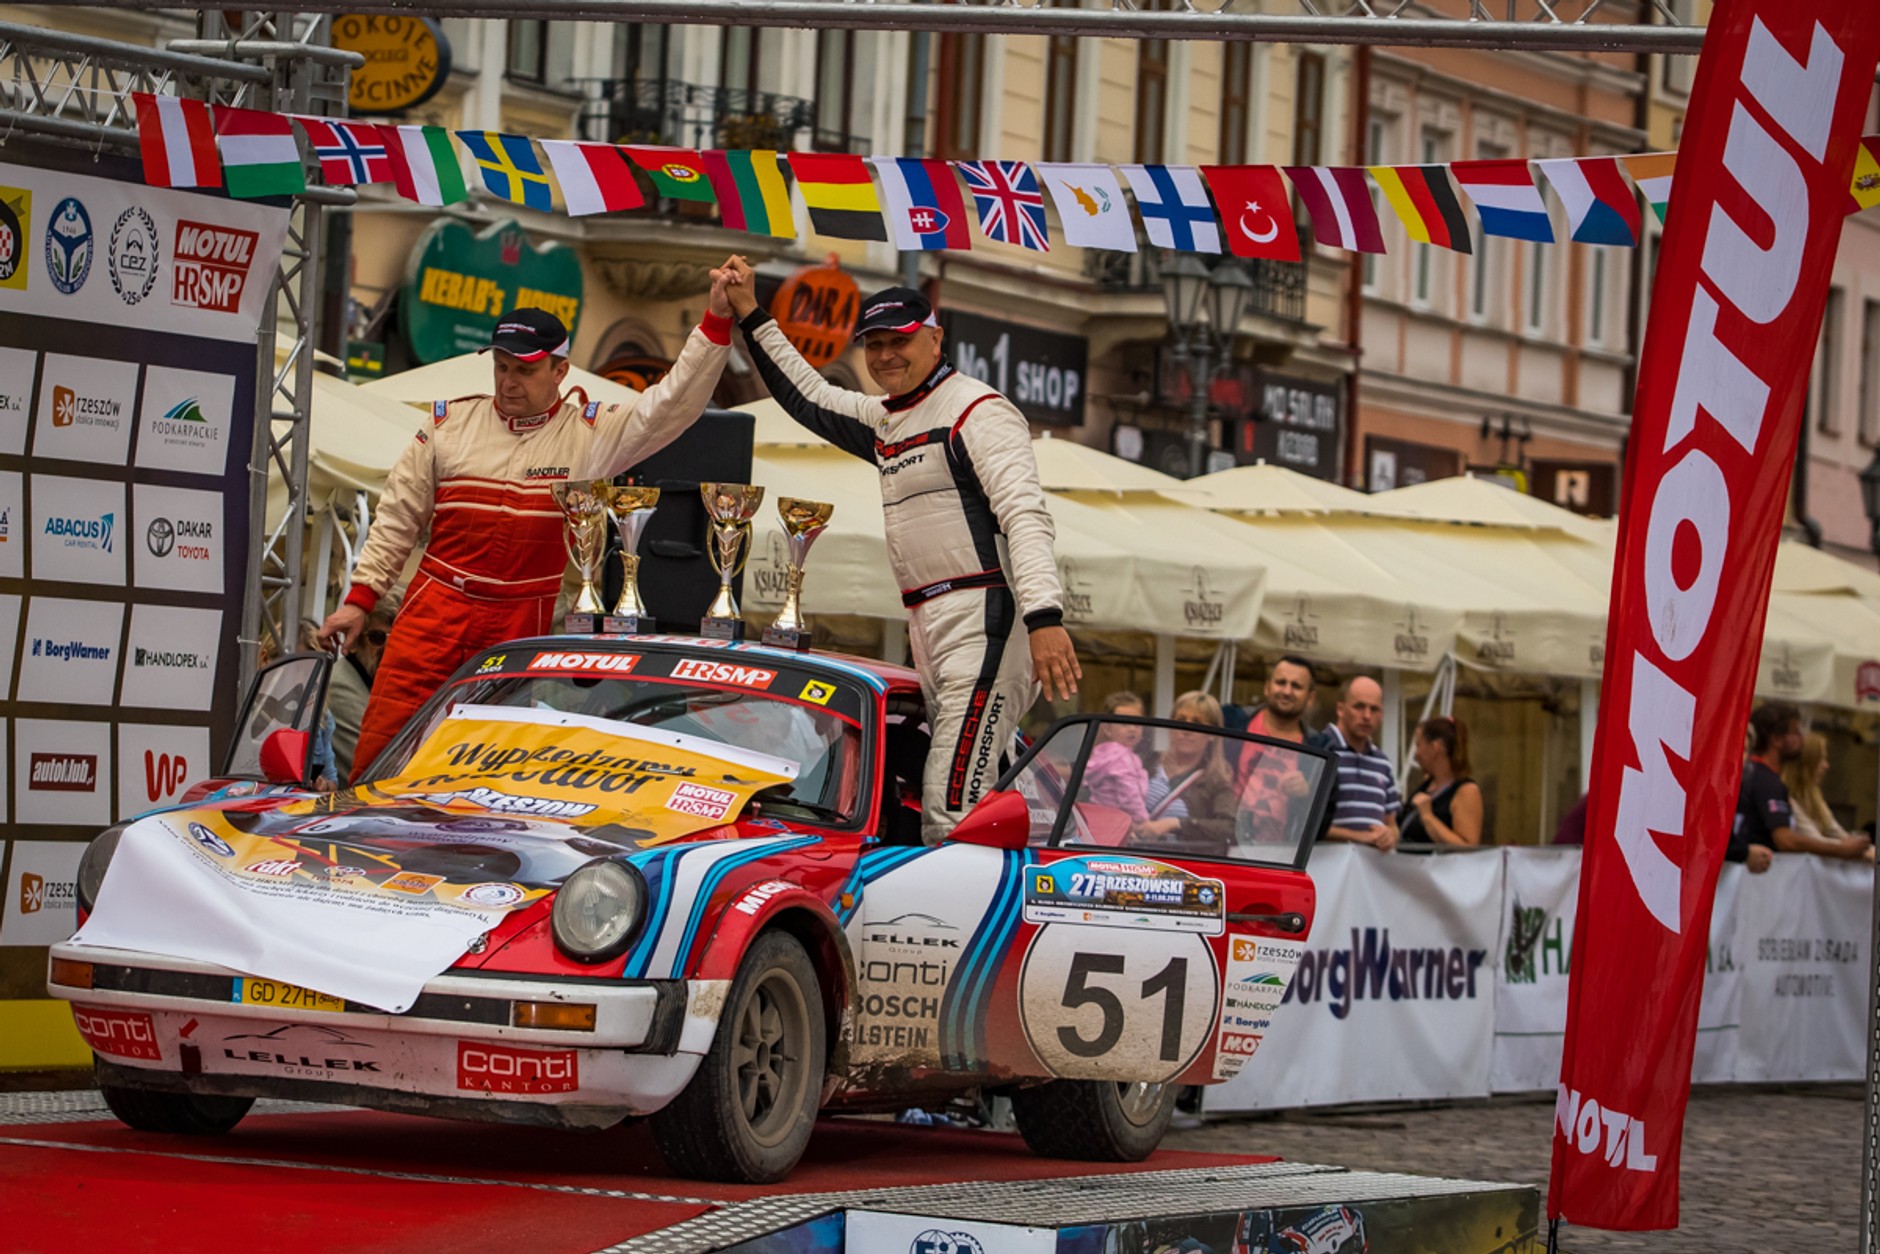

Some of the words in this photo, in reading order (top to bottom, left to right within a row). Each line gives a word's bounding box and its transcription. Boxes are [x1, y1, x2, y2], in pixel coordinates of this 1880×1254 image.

[177, 226, 252, 264] MOTUL
[174, 264, 242, 308] HRSMP
[1016, 361, 1080, 409] SHOP
[76, 398, 121, 416] rzeszów
[152, 421, 218, 440] PODKARPACKIE
[1615, 13, 1845, 935] MOTUL
[44, 517, 99, 539] ABACUS
[177, 520, 212, 539] DAKAR
[177, 545, 209, 560] TOYOTA
[45, 640, 110, 662] BorgWarner
[146, 649, 198, 669] HANDLOPEX
[532, 654, 633, 671] MOTUL
[675, 661, 772, 685] HRSMP
[969, 692, 1005, 804] MOTORSPORT
[678, 785, 733, 804] MOTUL
[670, 799, 723, 817] HRSMP
[1069, 874, 1096, 896] 27
[1106, 876, 1183, 894] RZESZOWSKI
[1282, 927, 1487, 1020] orgWarner
[249, 982, 277, 1003] GD
[280, 984, 317, 1006] 27H
[1228, 982, 1284, 996] PODKARPAC
[1056, 951, 1188, 1061] 51
[75, 1012, 152, 1043] conti
[1236, 1017, 1270, 1029] BorgW
[224, 1049, 381, 1072] LELLEK
[463, 1049, 572, 1078] conti
[284, 1066, 334, 1079] Group
[465, 1077, 572, 1092] KANTOR
